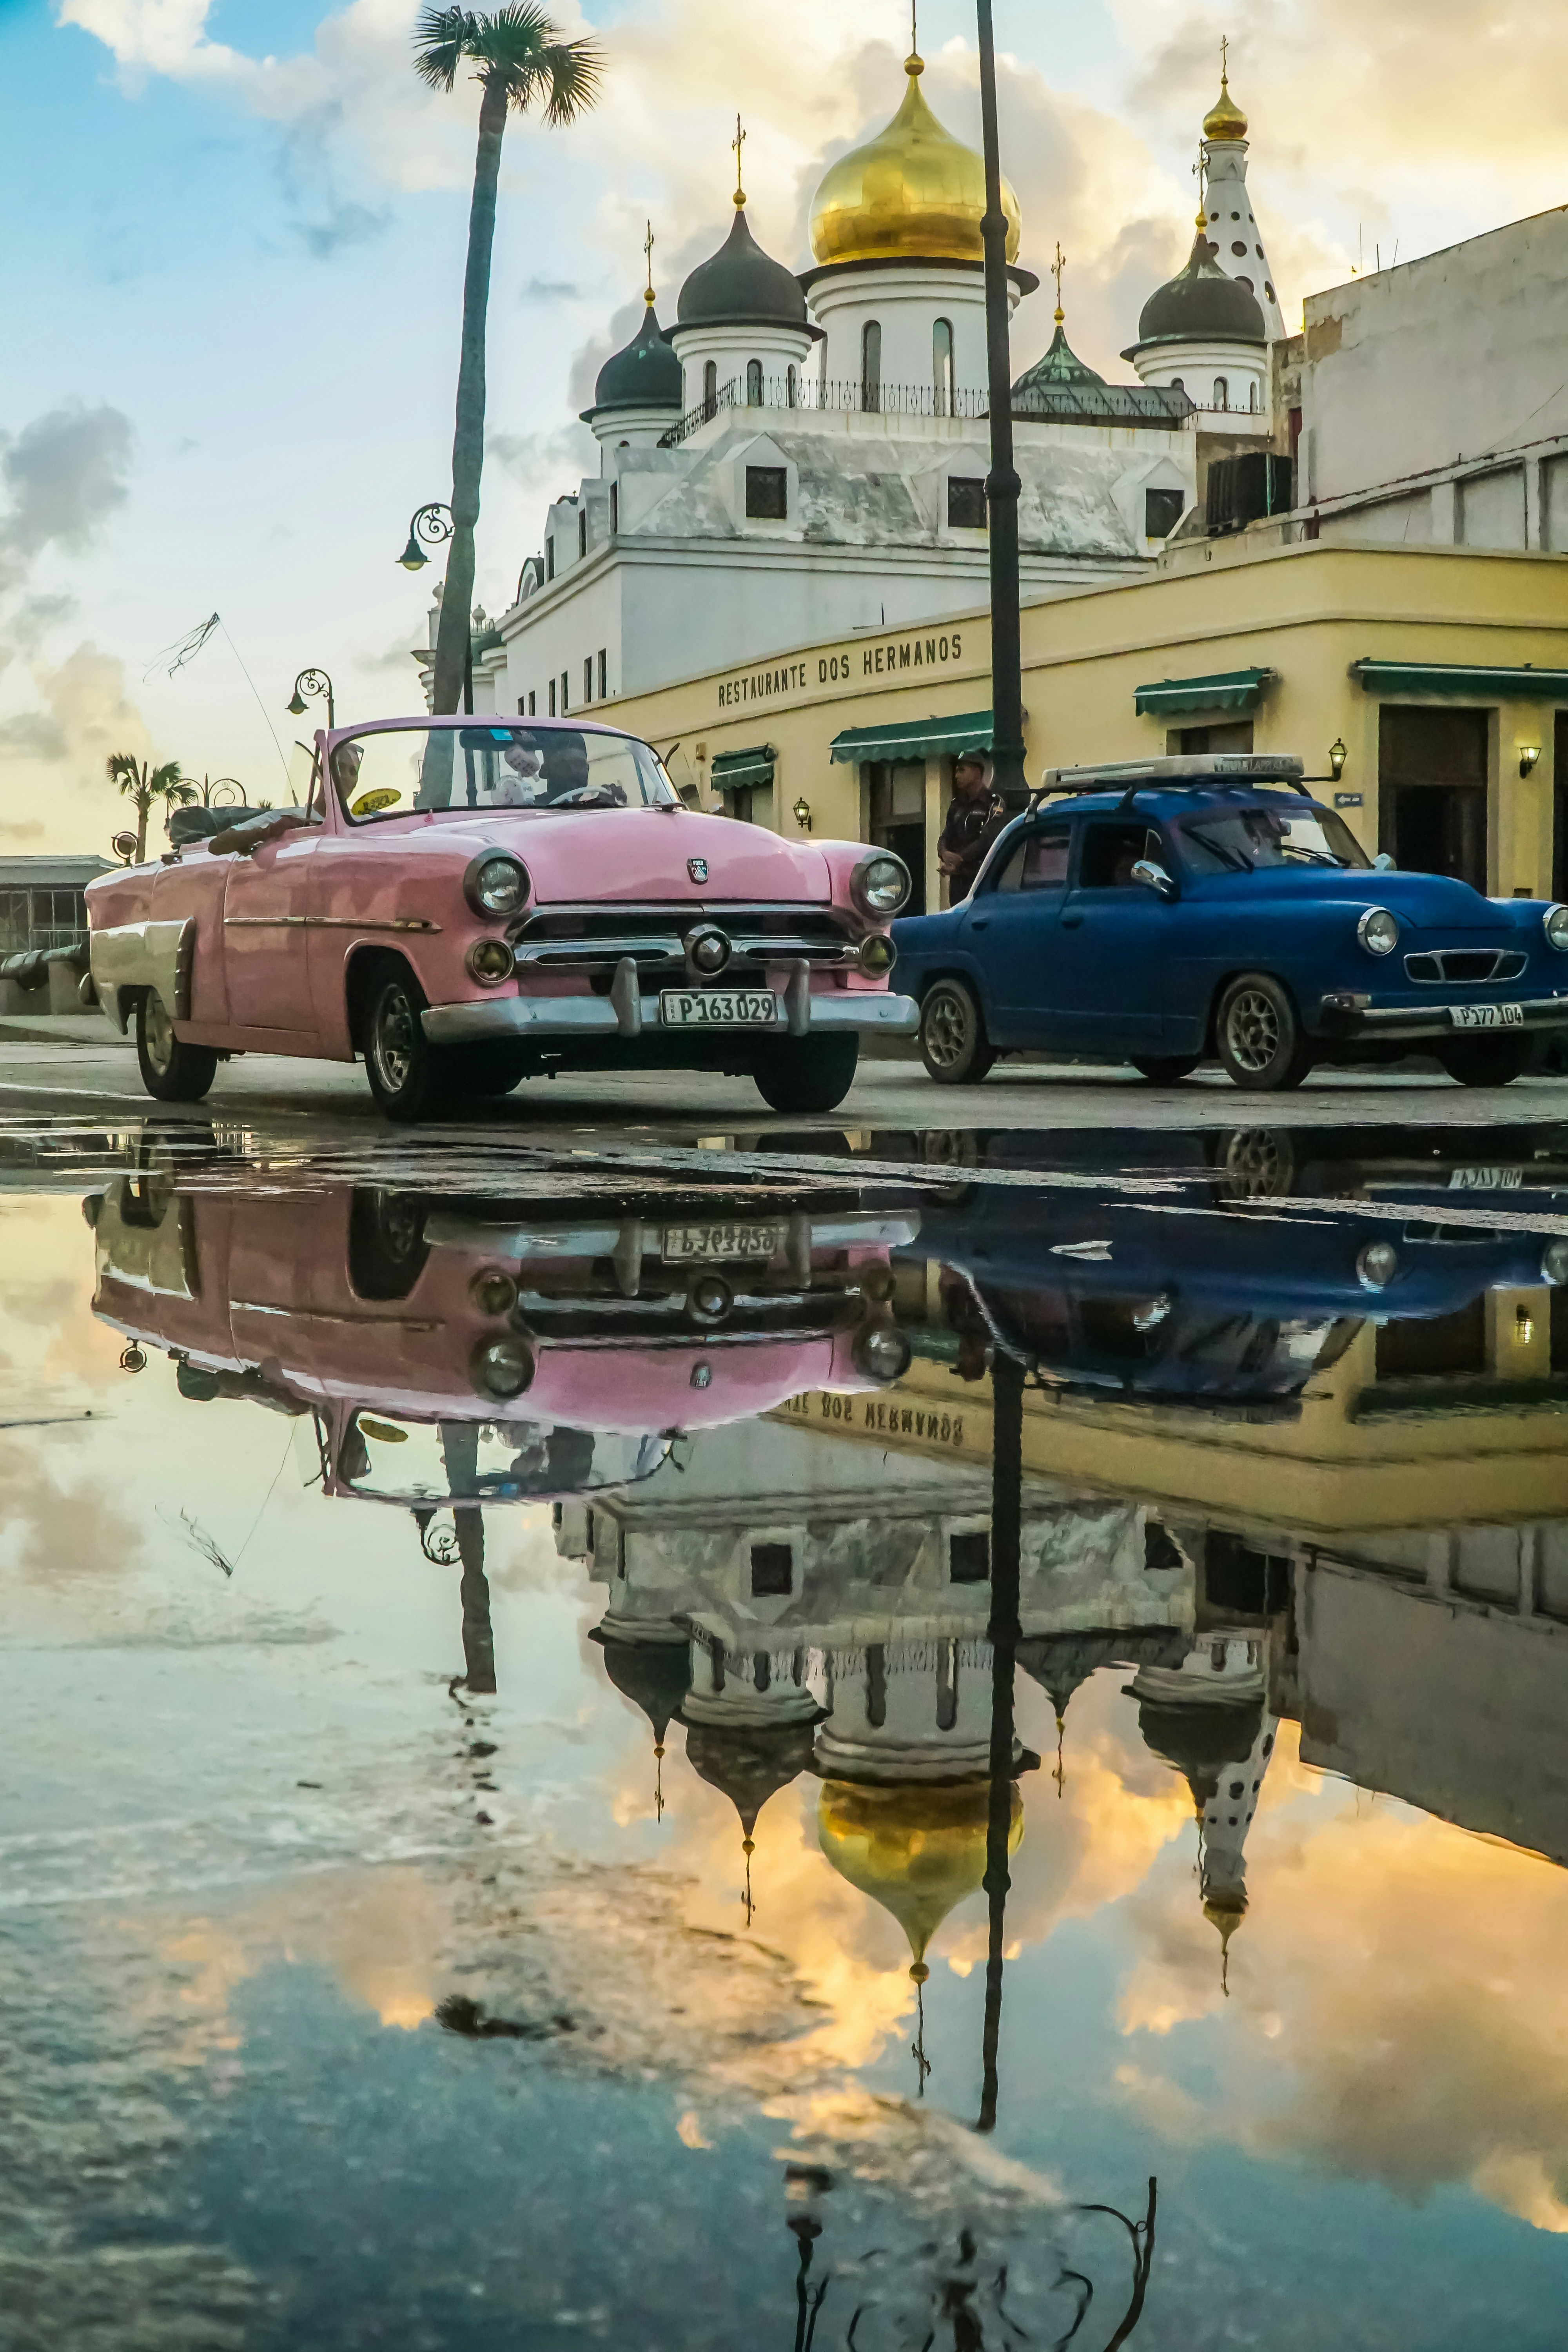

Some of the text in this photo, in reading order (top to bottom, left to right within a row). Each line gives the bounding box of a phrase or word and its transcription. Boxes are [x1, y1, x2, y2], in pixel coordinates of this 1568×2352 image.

[719, 634, 961, 707] RESTAURANTE DOS HERMANOS
